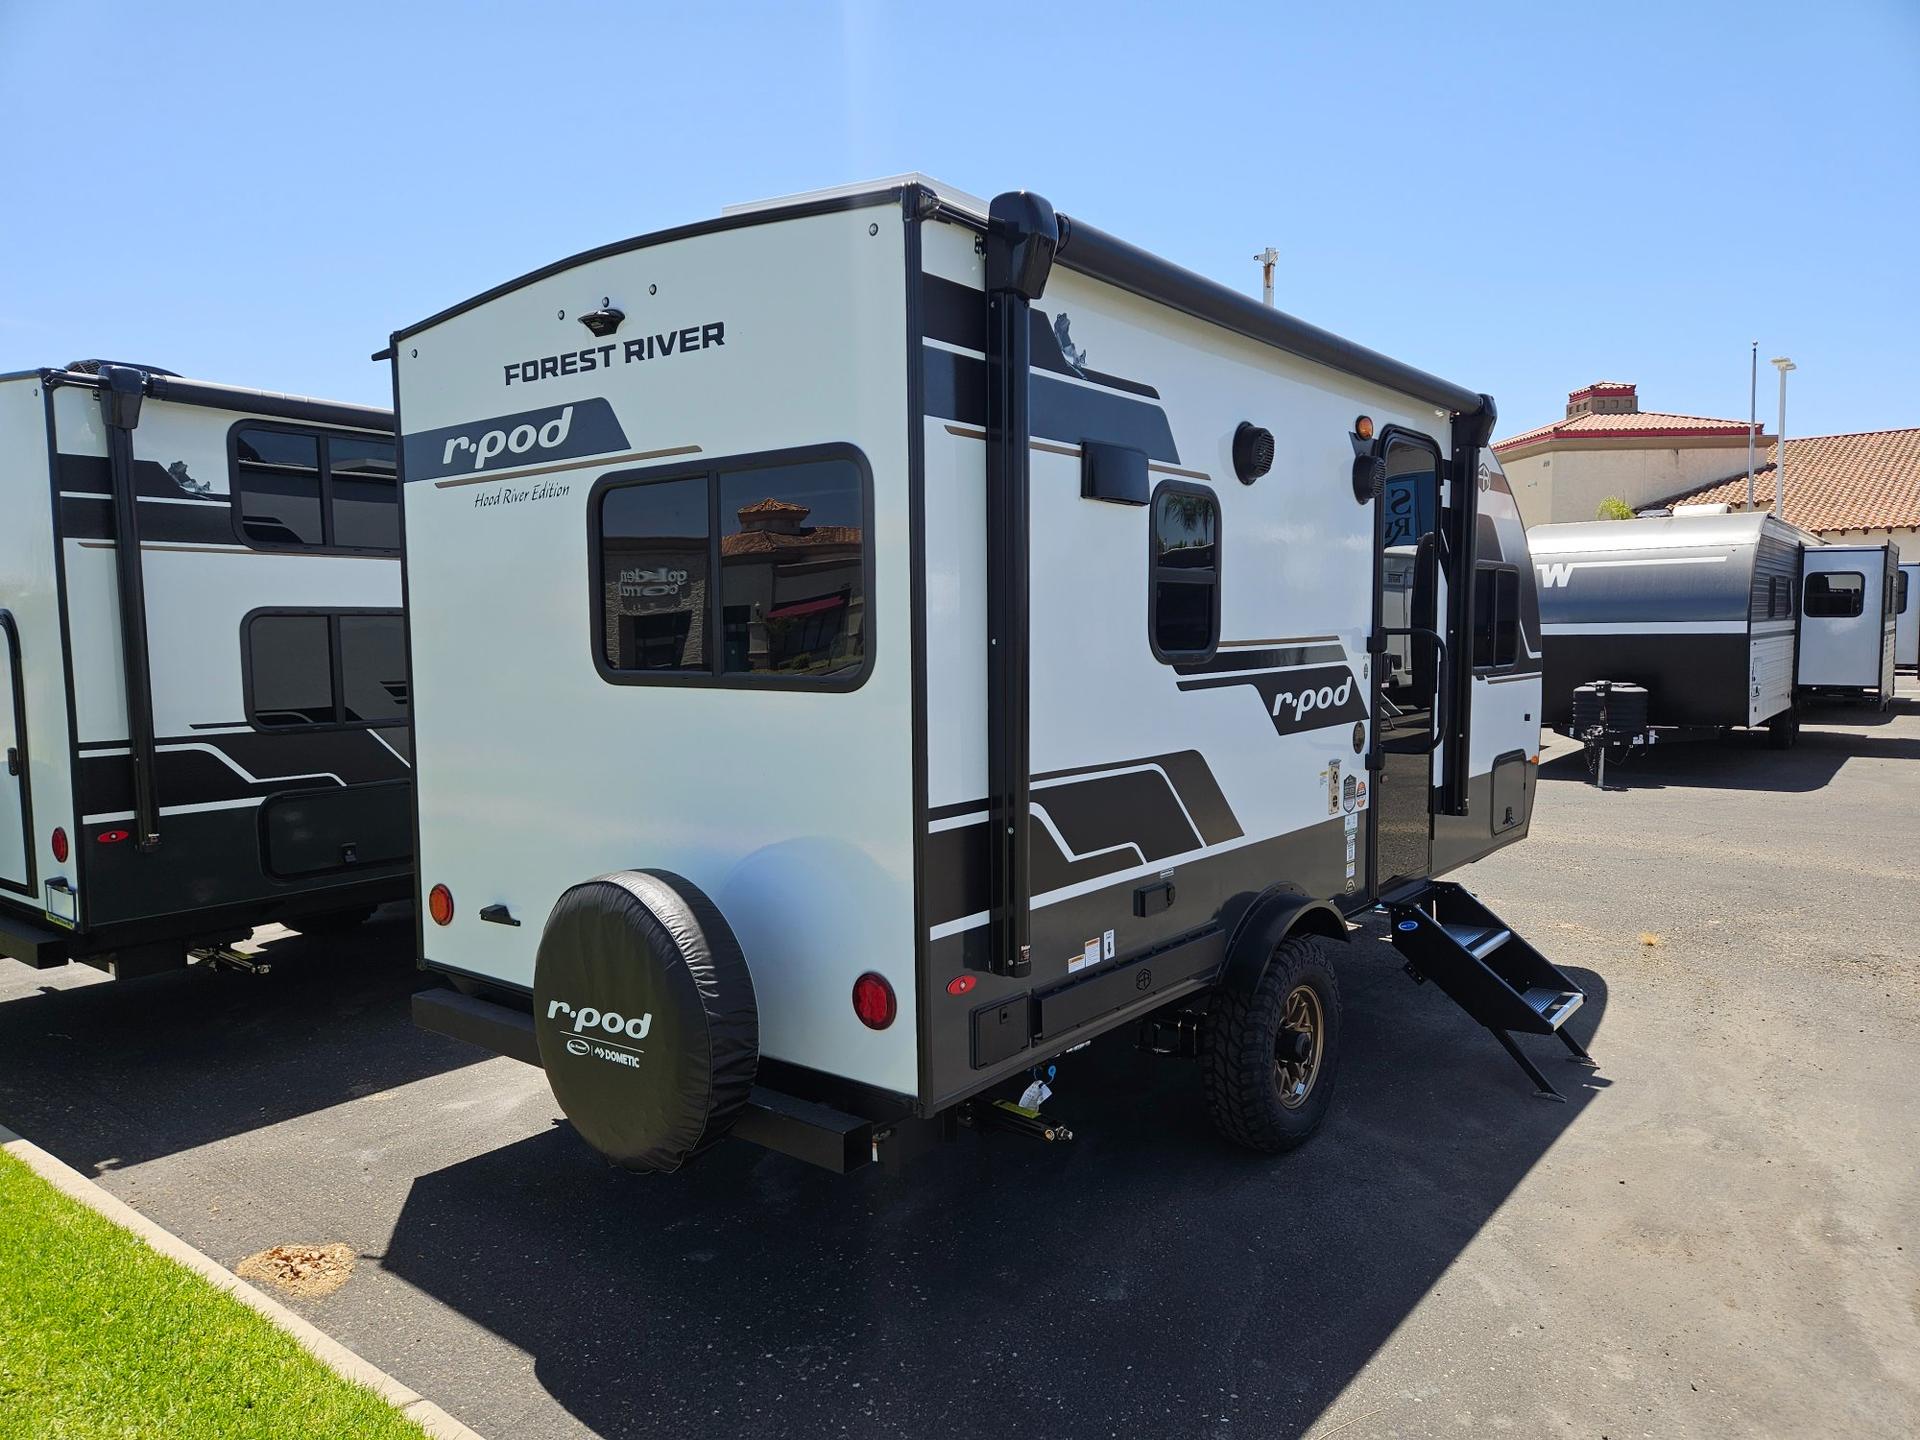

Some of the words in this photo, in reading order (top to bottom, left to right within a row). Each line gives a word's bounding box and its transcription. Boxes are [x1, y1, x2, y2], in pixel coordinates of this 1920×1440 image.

[504, 344, 616, 386] FOREST
[623, 321, 725, 364] RIVER
[475, 488, 502, 508] Hood
[502, 488, 530, 505] River
[531, 481, 570, 501] Edition
[605, 1049, 640, 1068] DOMETIC
